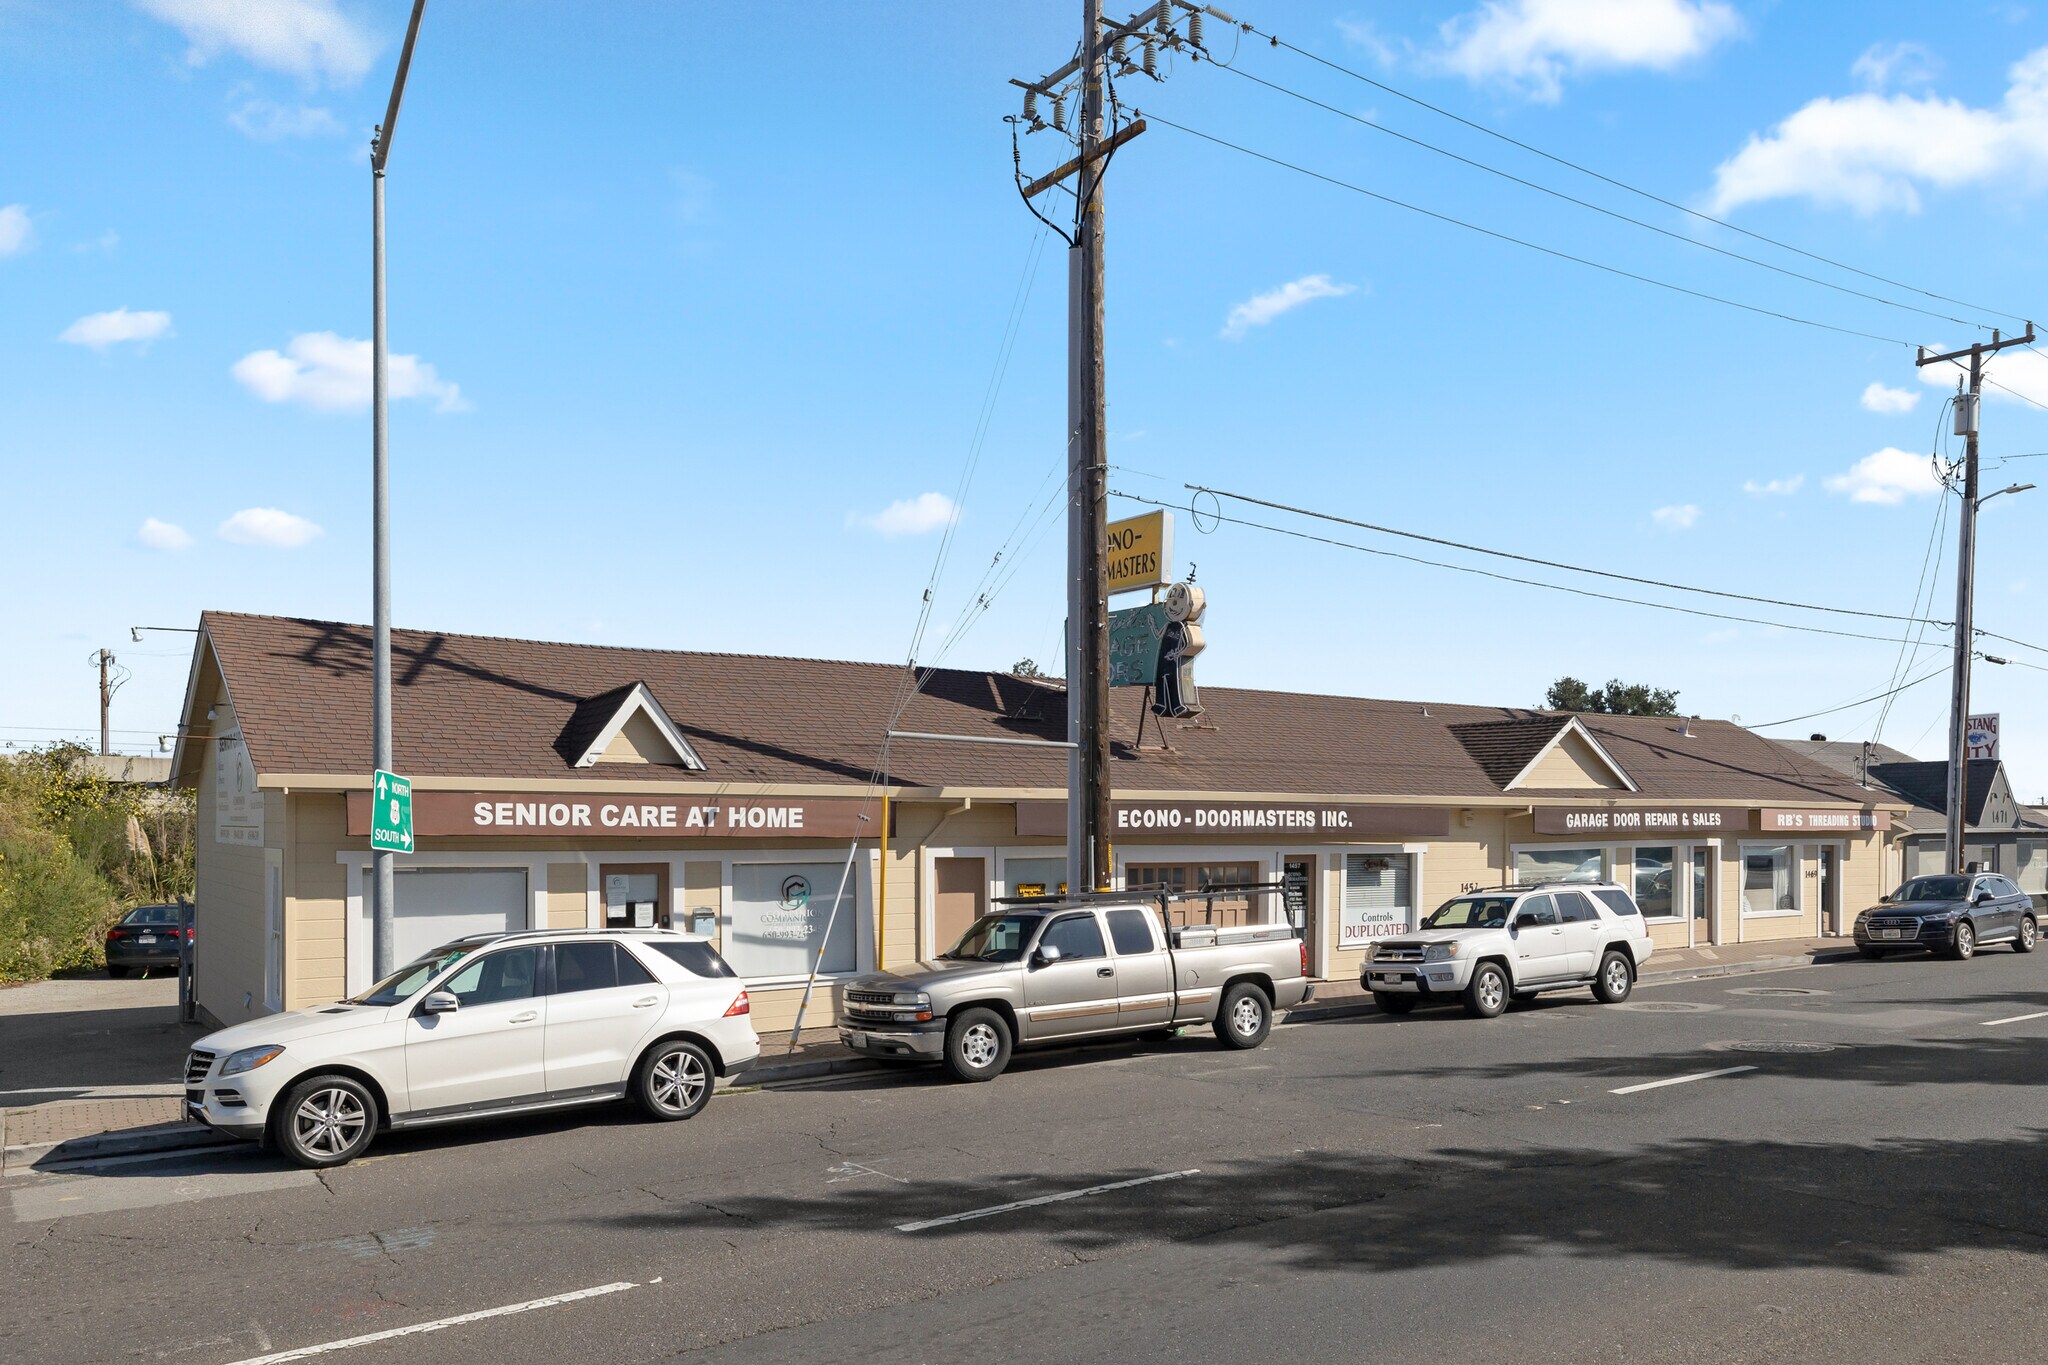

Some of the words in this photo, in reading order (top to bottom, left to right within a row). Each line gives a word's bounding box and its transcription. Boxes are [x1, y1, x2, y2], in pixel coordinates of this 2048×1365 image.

[391, 781, 409, 797] NORTH
[473, 802, 592, 826] SENIOR
[600, 804, 677, 827] CARE
[685, 806, 720, 828] AT
[728, 807, 804, 828] HOME
[1322, 811, 1353, 828] INC.
[1566, 813, 1609, 828] GARAGE
[1613, 813, 1641, 827] DOOR
[1645, 813, 1678, 826] REPAIR
[1682, 813, 1689, 826] &
[1693, 813, 1721, 826] SALES
[1777, 814, 1803, 827] RB'S
[1809, 815, 1849, 827] THREADING
[1853, 815, 1877, 827] STUDIO
[1992, 810, 2008, 823] 1471
[374, 828, 400, 844] SOUTH
[1805, 870, 1818, 879] 1469
[1361, 912, 1394, 922] Controls
[1345, 923, 1410, 938] DUPLICATED
